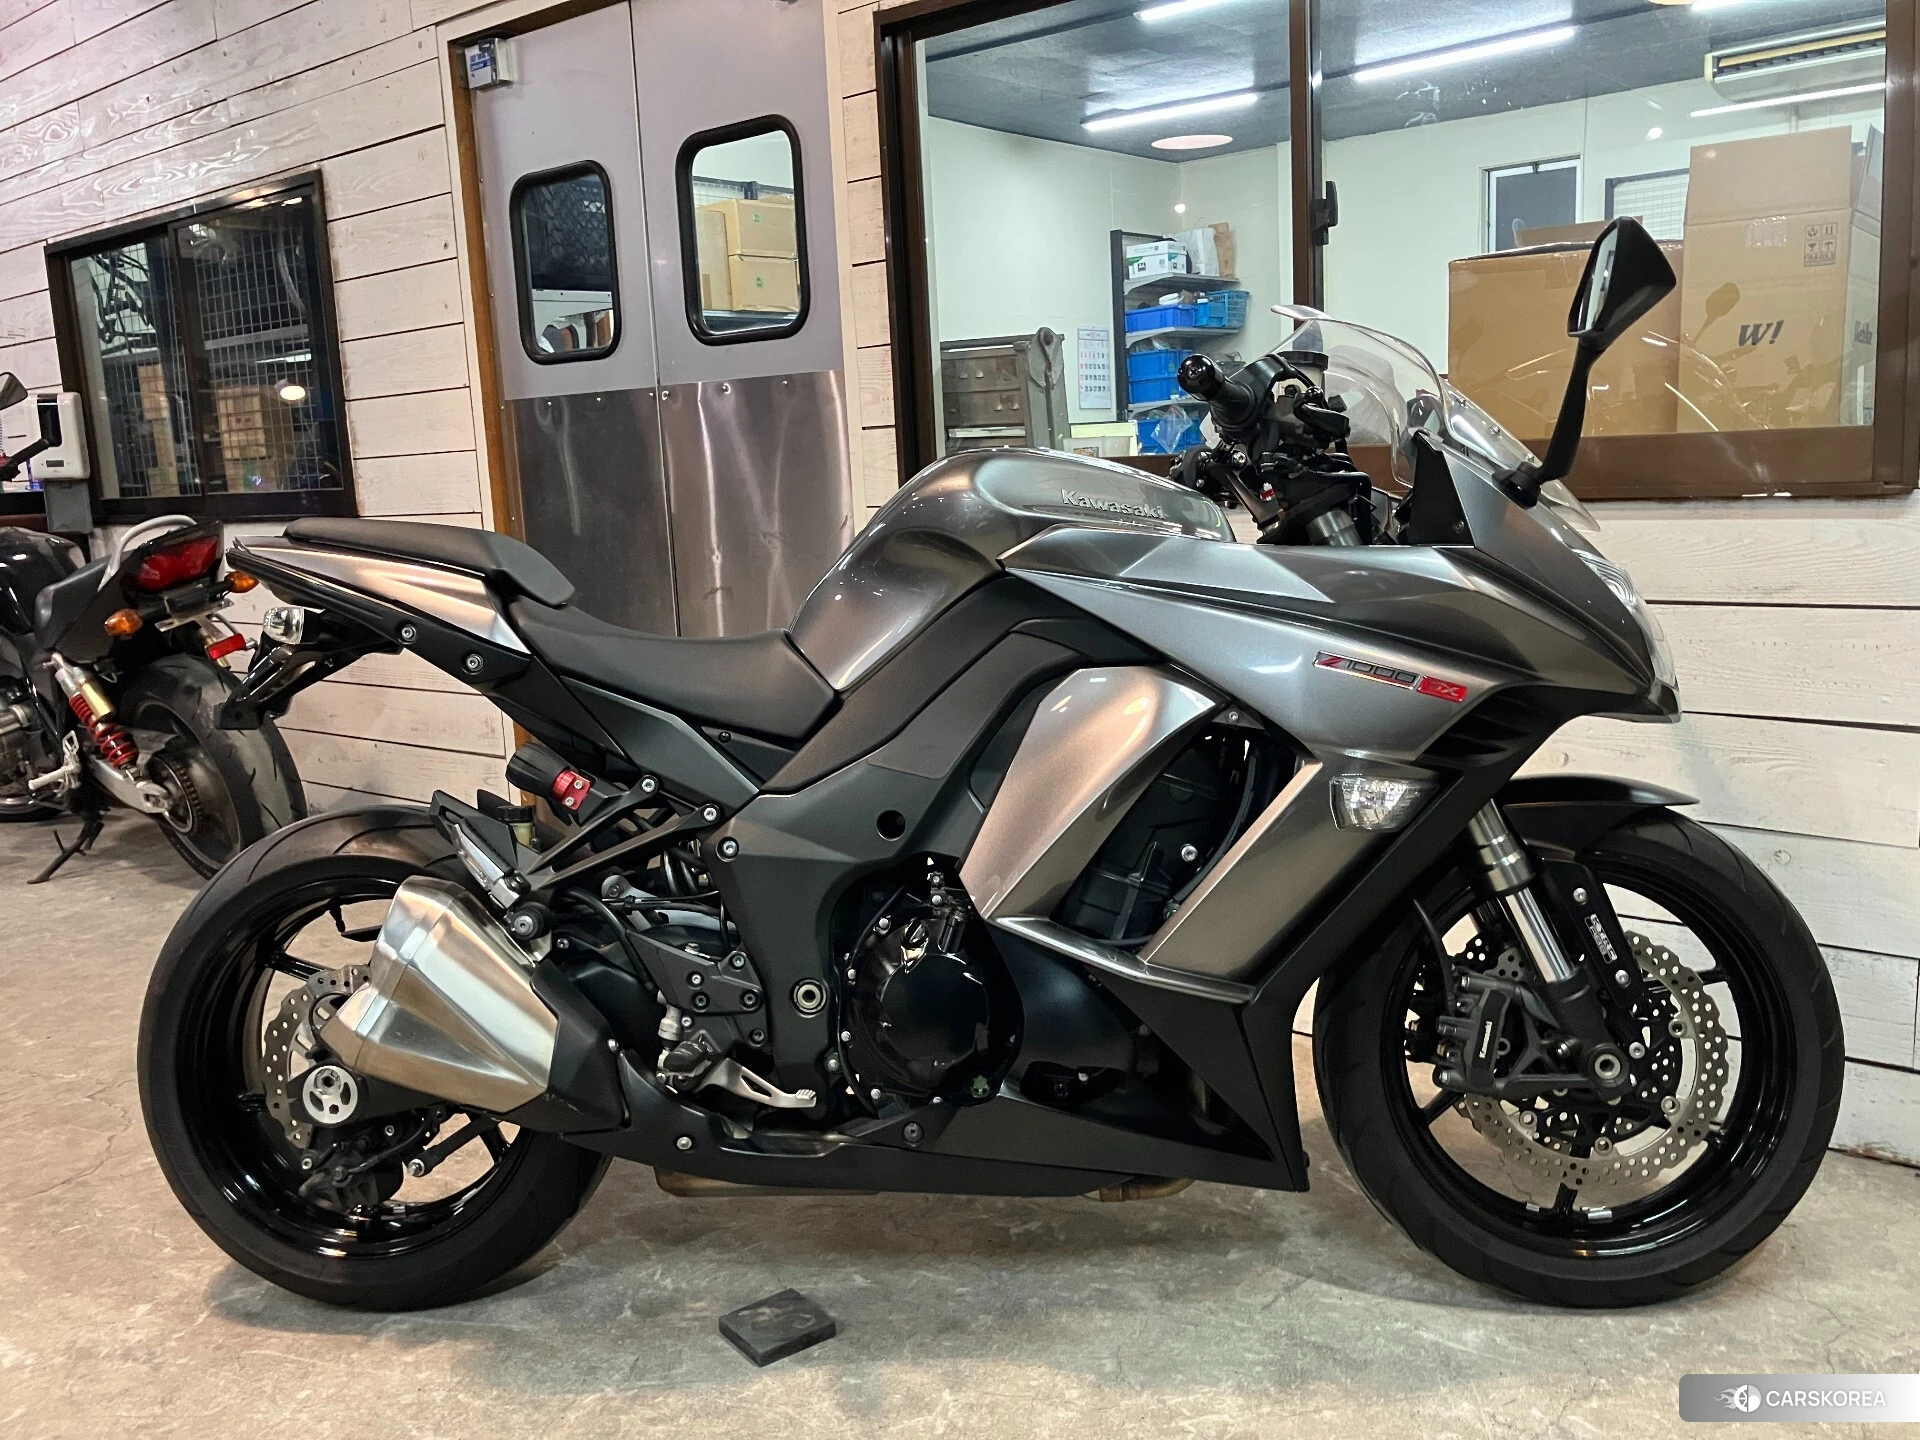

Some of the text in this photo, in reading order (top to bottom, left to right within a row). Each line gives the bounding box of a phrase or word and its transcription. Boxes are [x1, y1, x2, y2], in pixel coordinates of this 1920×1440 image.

[1738, 319, 1784, 347] W!
[1061, 488, 1165, 520] Kawasaki
[1317, 654, 1417, 684] Z1000
